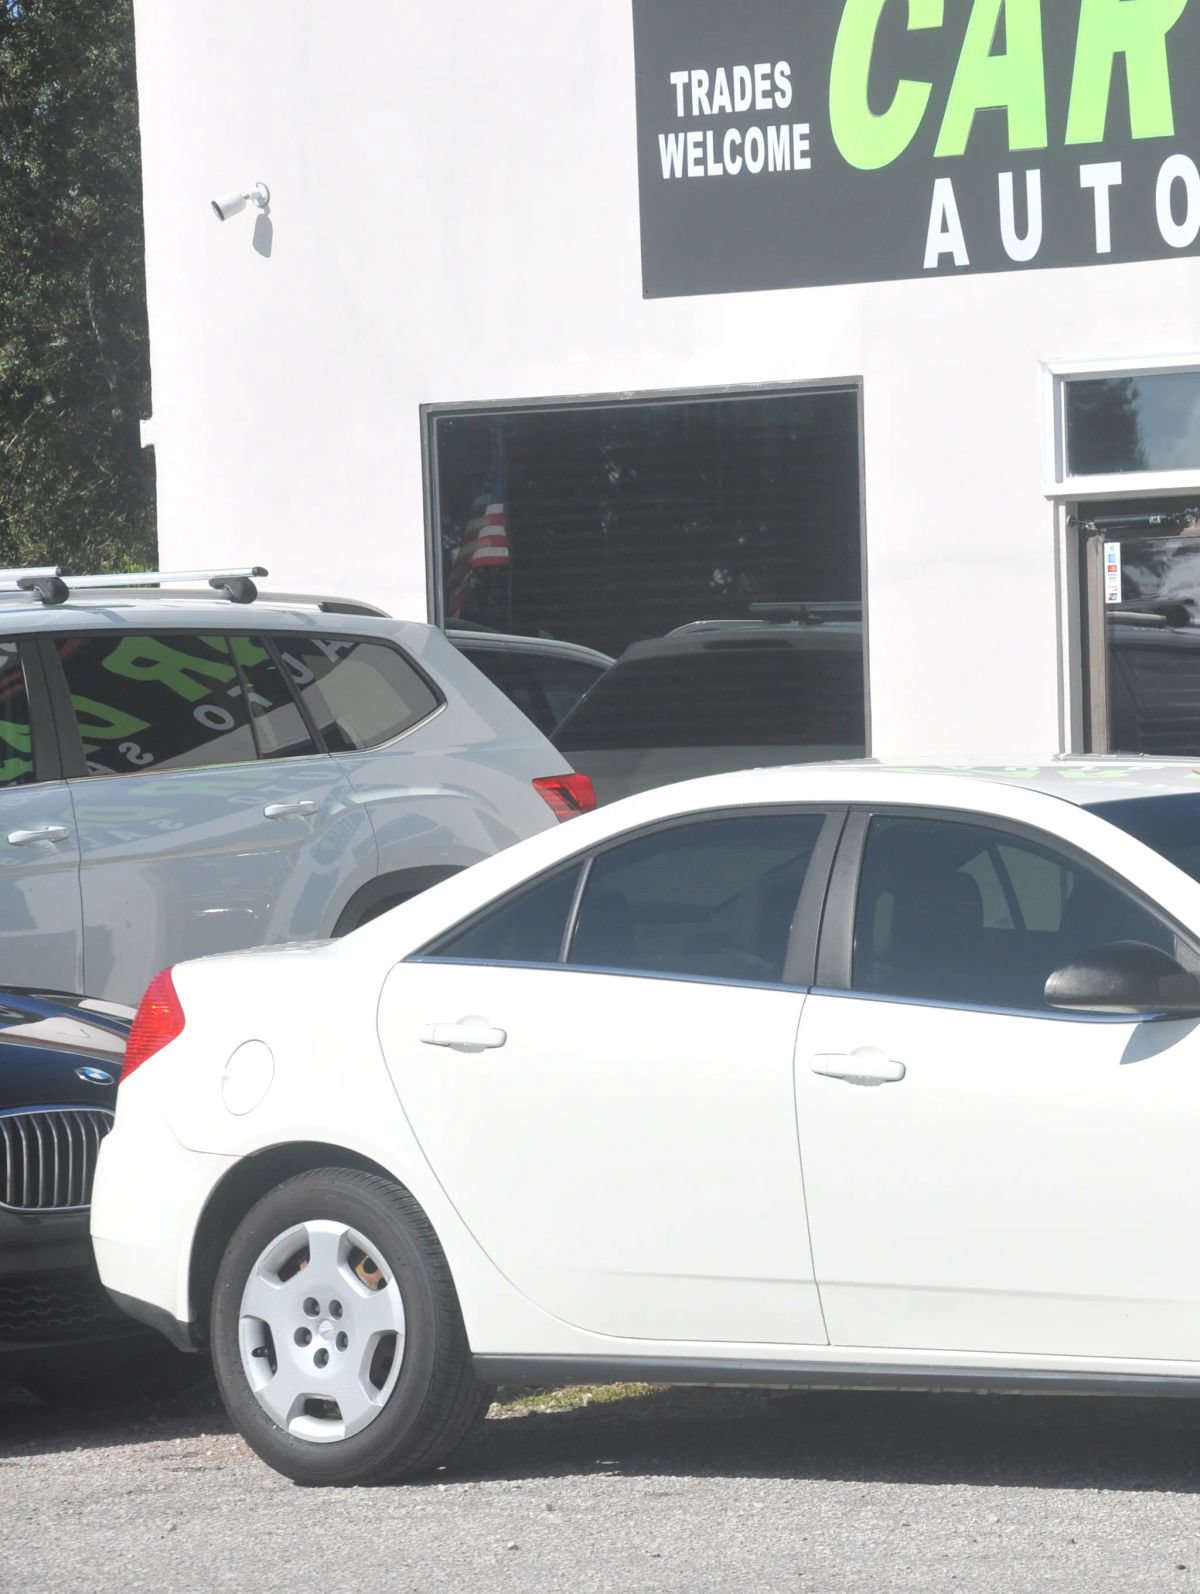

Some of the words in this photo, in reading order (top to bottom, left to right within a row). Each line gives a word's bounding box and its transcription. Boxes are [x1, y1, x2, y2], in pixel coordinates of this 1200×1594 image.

[670, 61, 793, 117] TRADES
[829, 0, 1186, 170] CAR
[658, 124, 812, 179] WELCOME
